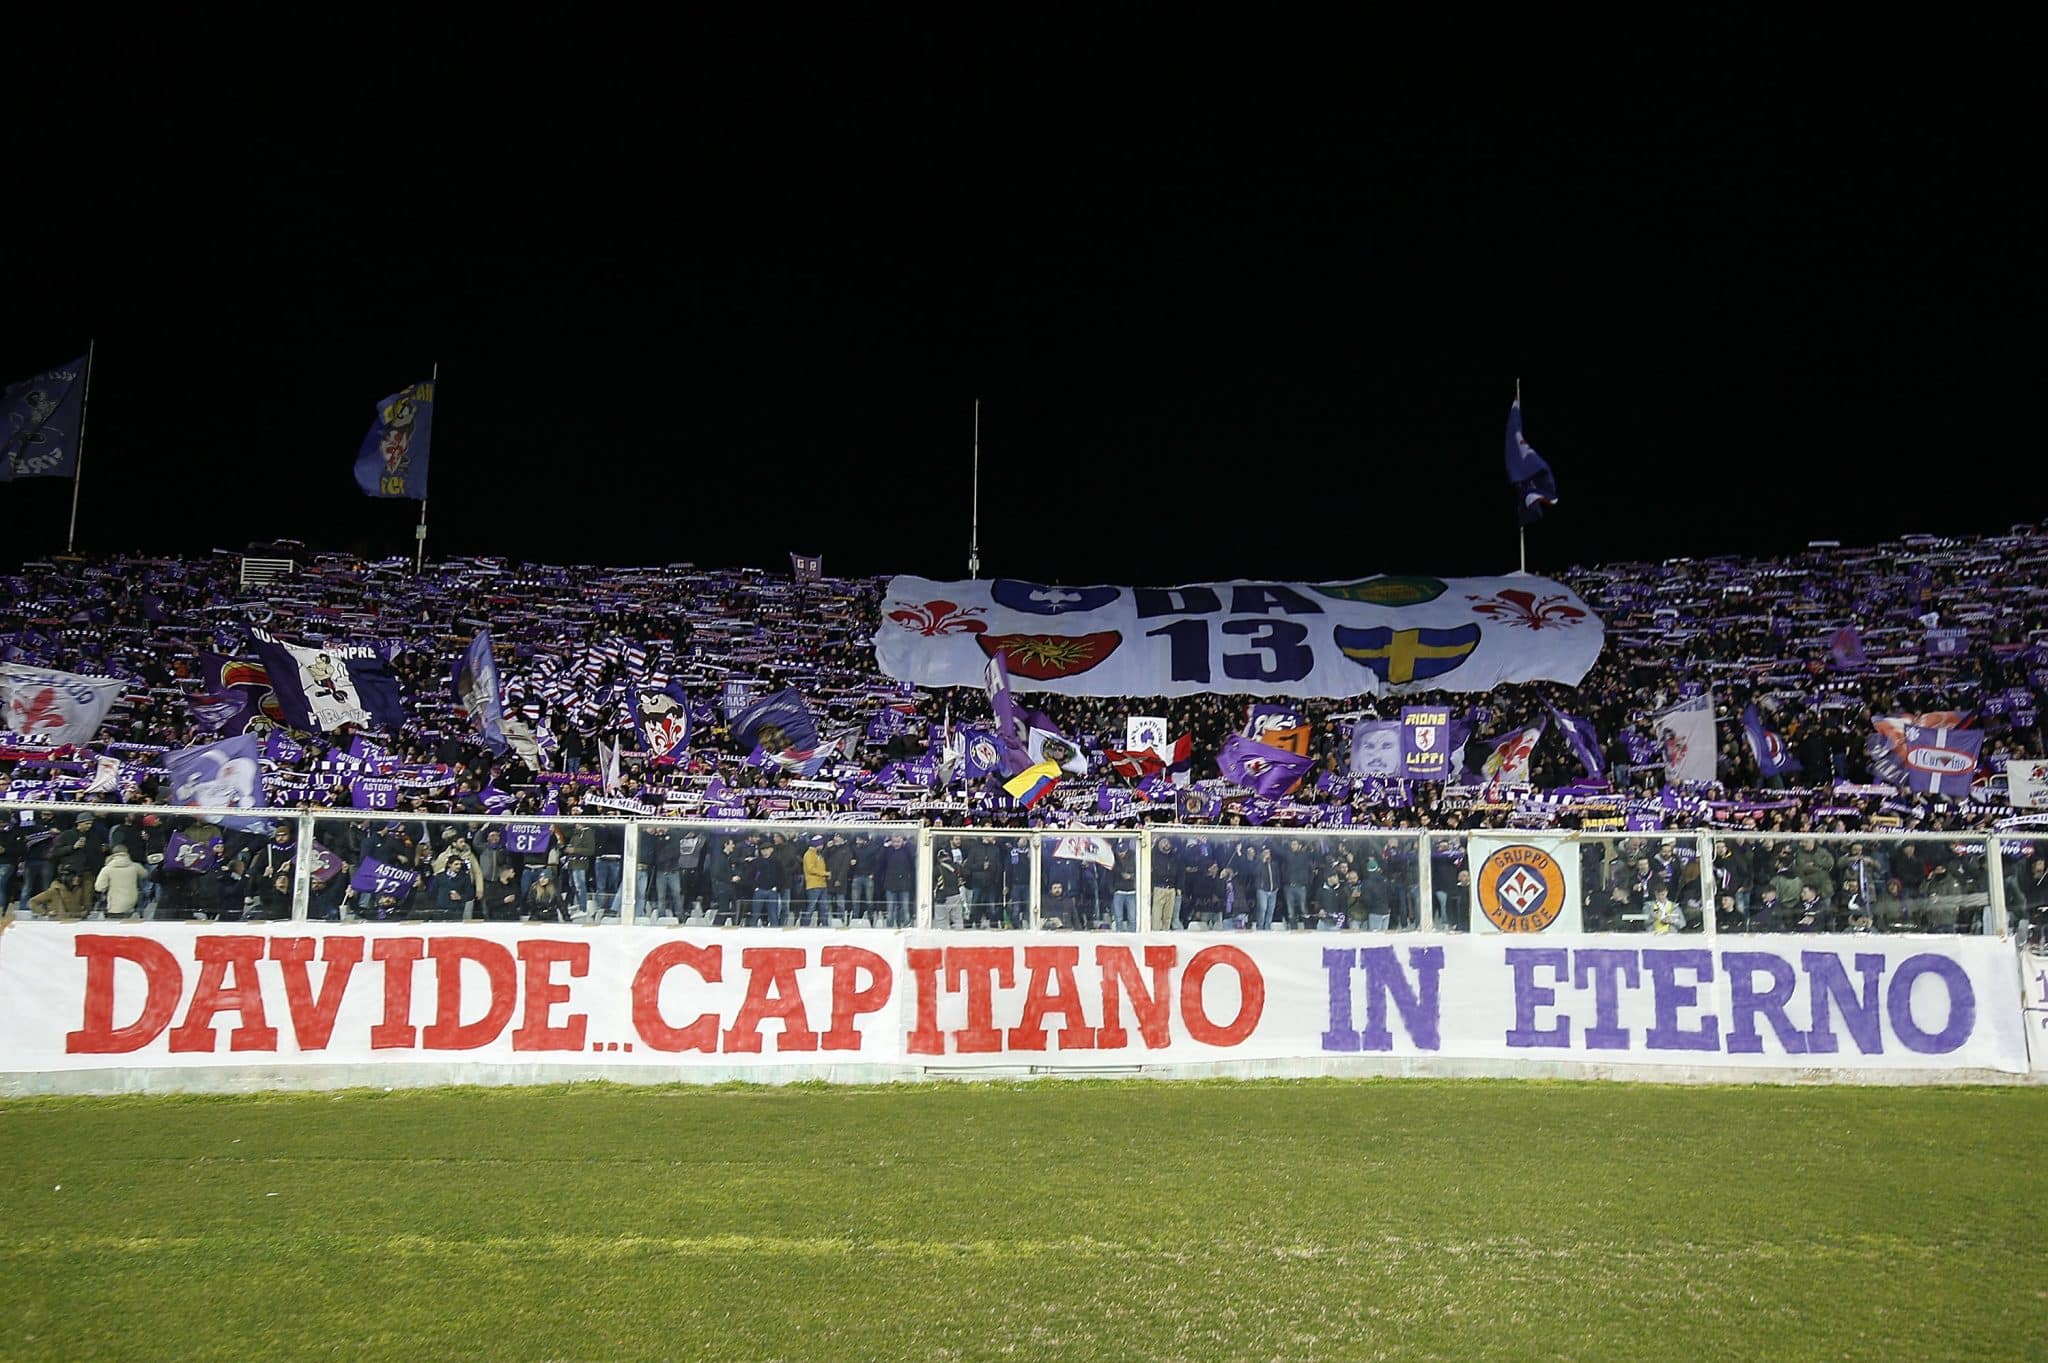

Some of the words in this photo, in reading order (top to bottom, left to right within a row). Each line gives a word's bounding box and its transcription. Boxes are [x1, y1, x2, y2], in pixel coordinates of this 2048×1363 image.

[1133, 585, 1325, 619] DA
[1146, 619, 1314, 683] 13
[1406, 752, 1444, 765] LIPPI
[363, 782, 394, 792] ASTORI
[913, 774, 929, 785] 13
[367, 792, 387, 807] 13
[717, 807, 745, 816] ASTORI
[1495, 850, 1549, 869] GRUPPO
[375, 863, 413, 881] ASTORI
[375, 878, 400, 894] 13
[1491, 907, 1553, 931] PIAGGE
[630, 942, 1264, 1055] CAPITANO
[1323, 947, 1444, 1051] IN
[1506, 948, 1974, 1054] ETERNO
